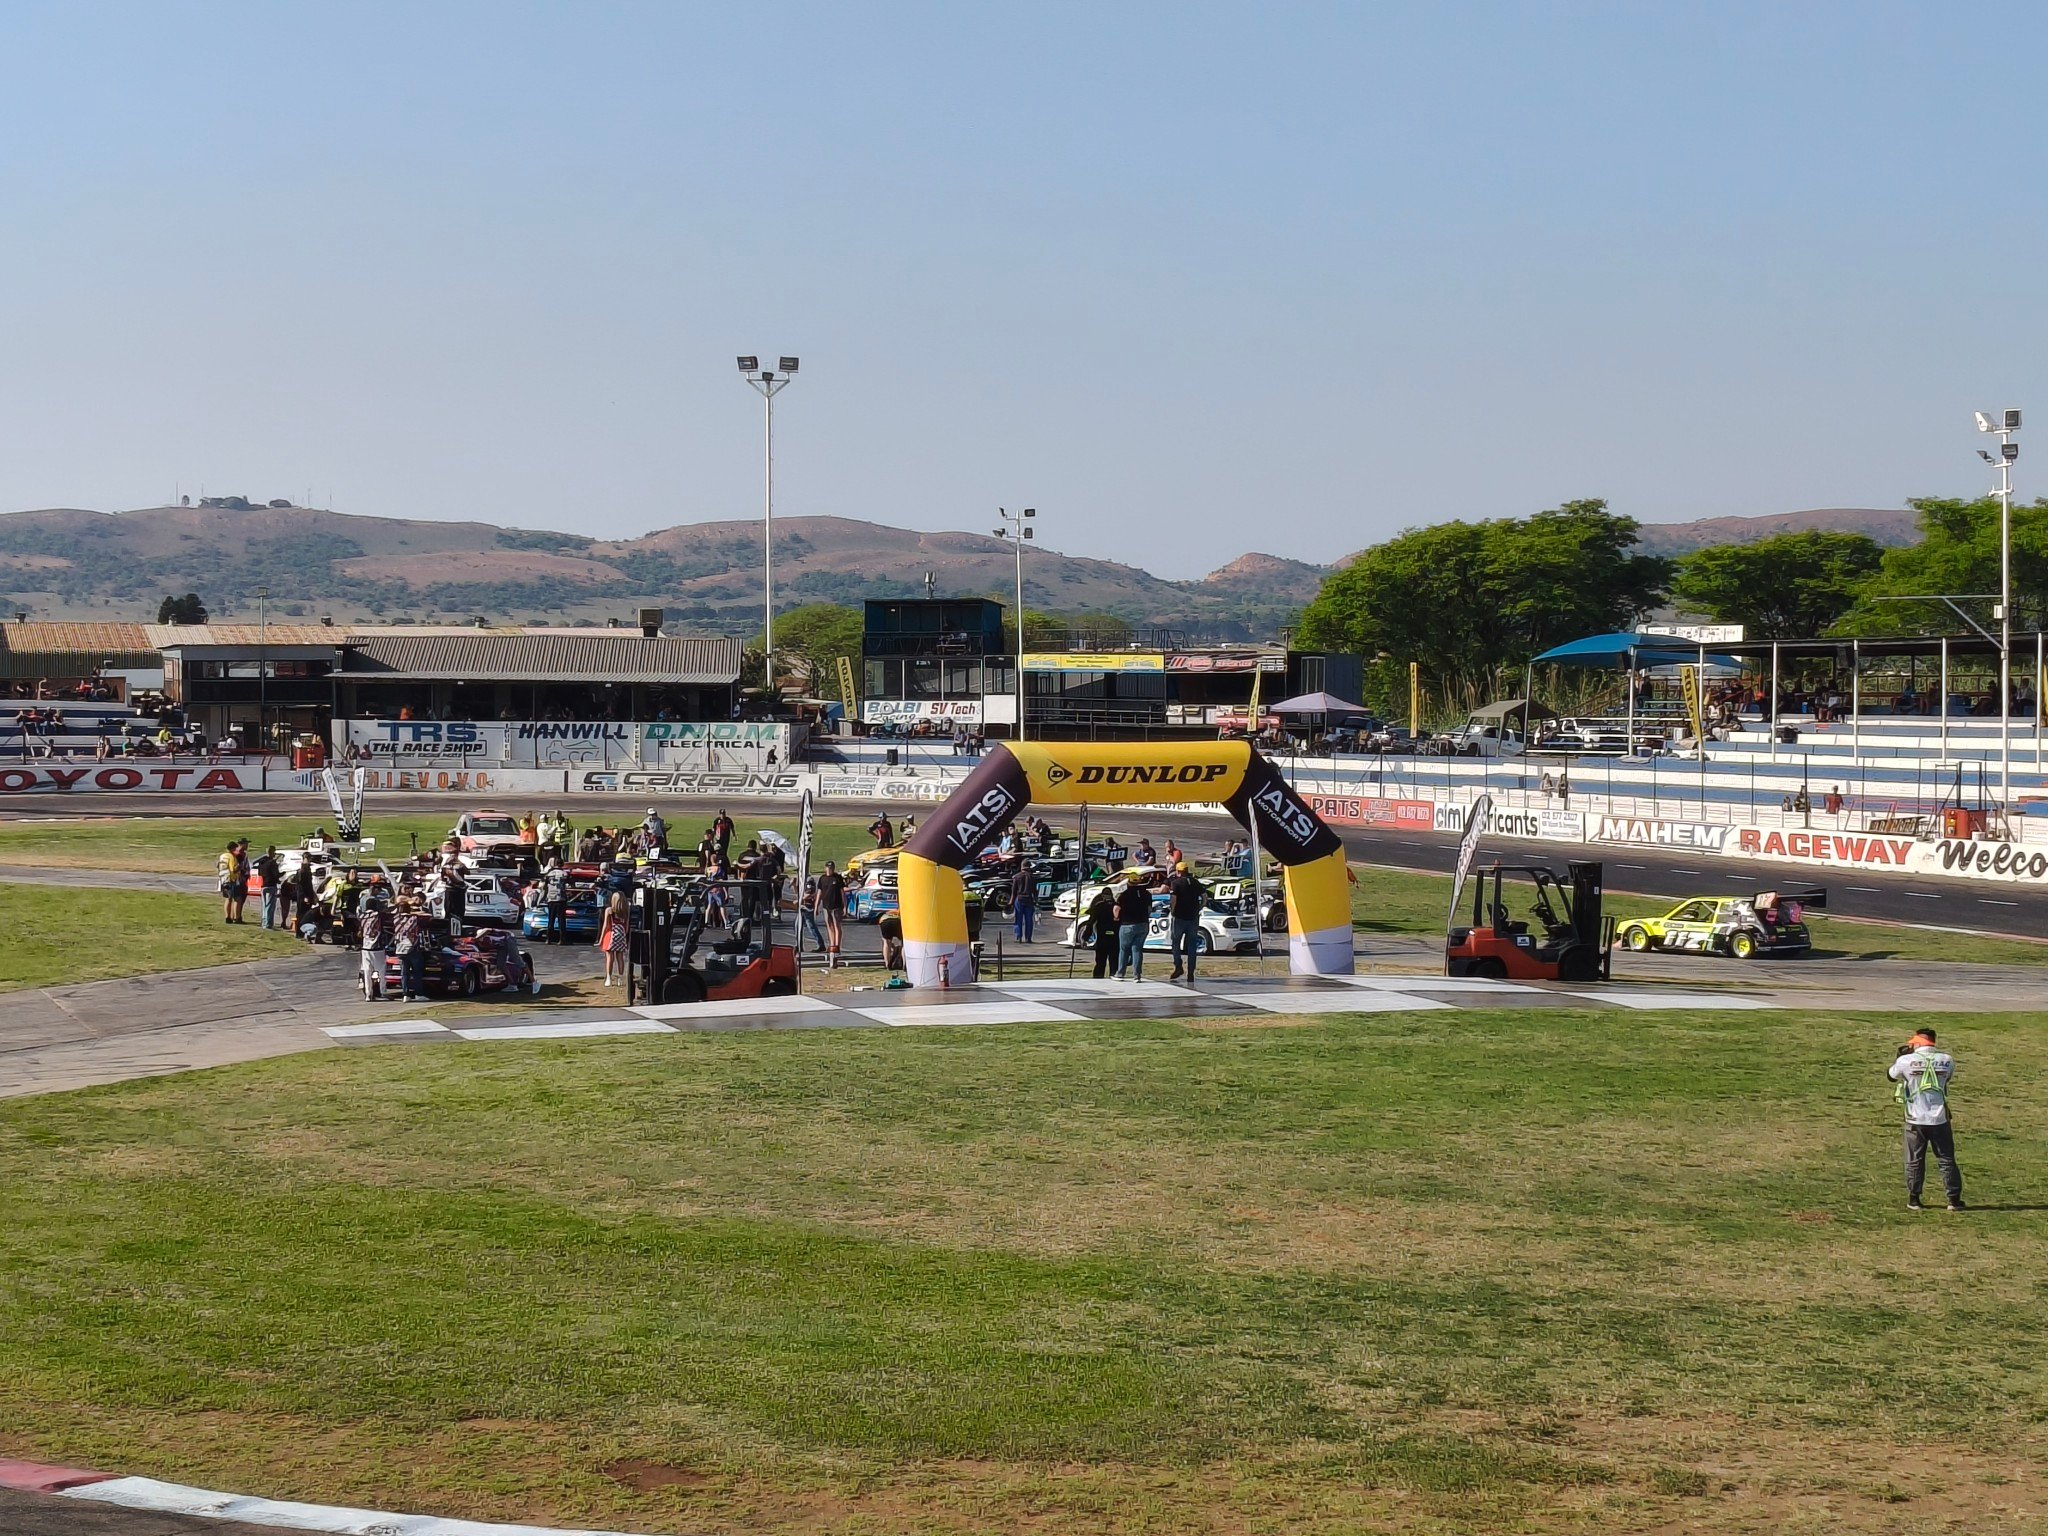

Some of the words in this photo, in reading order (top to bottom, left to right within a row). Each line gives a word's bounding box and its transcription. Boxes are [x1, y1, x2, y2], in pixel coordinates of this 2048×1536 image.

[930, 703, 948, 714] SV
[377, 722, 477, 742] TRS
[518, 723, 629, 740] HANWILL
[372, 743, 399, 752] THE
[402, 743, 440, 752] RACE
[443, 743, 482, 753] SHOP
[660, 740, 765, 749] ELECTRICAL
[0, 768, 243, 791] OYOTA
[1075, 765, 1228, 784] DUNLOP
[956, 789, 1007, 845] ATS
[1262, 790, 1311, 837] ATS
[1311, 797, 1361, 818] PATS
[965, 801, 1012, 850] MOTORSPORT
[1256, 798, 1304, 842] MOTORSPORT
[1599, 818, 1727, 848] MAHEM
[1740, 829, 1914, 865] RACEWAY
